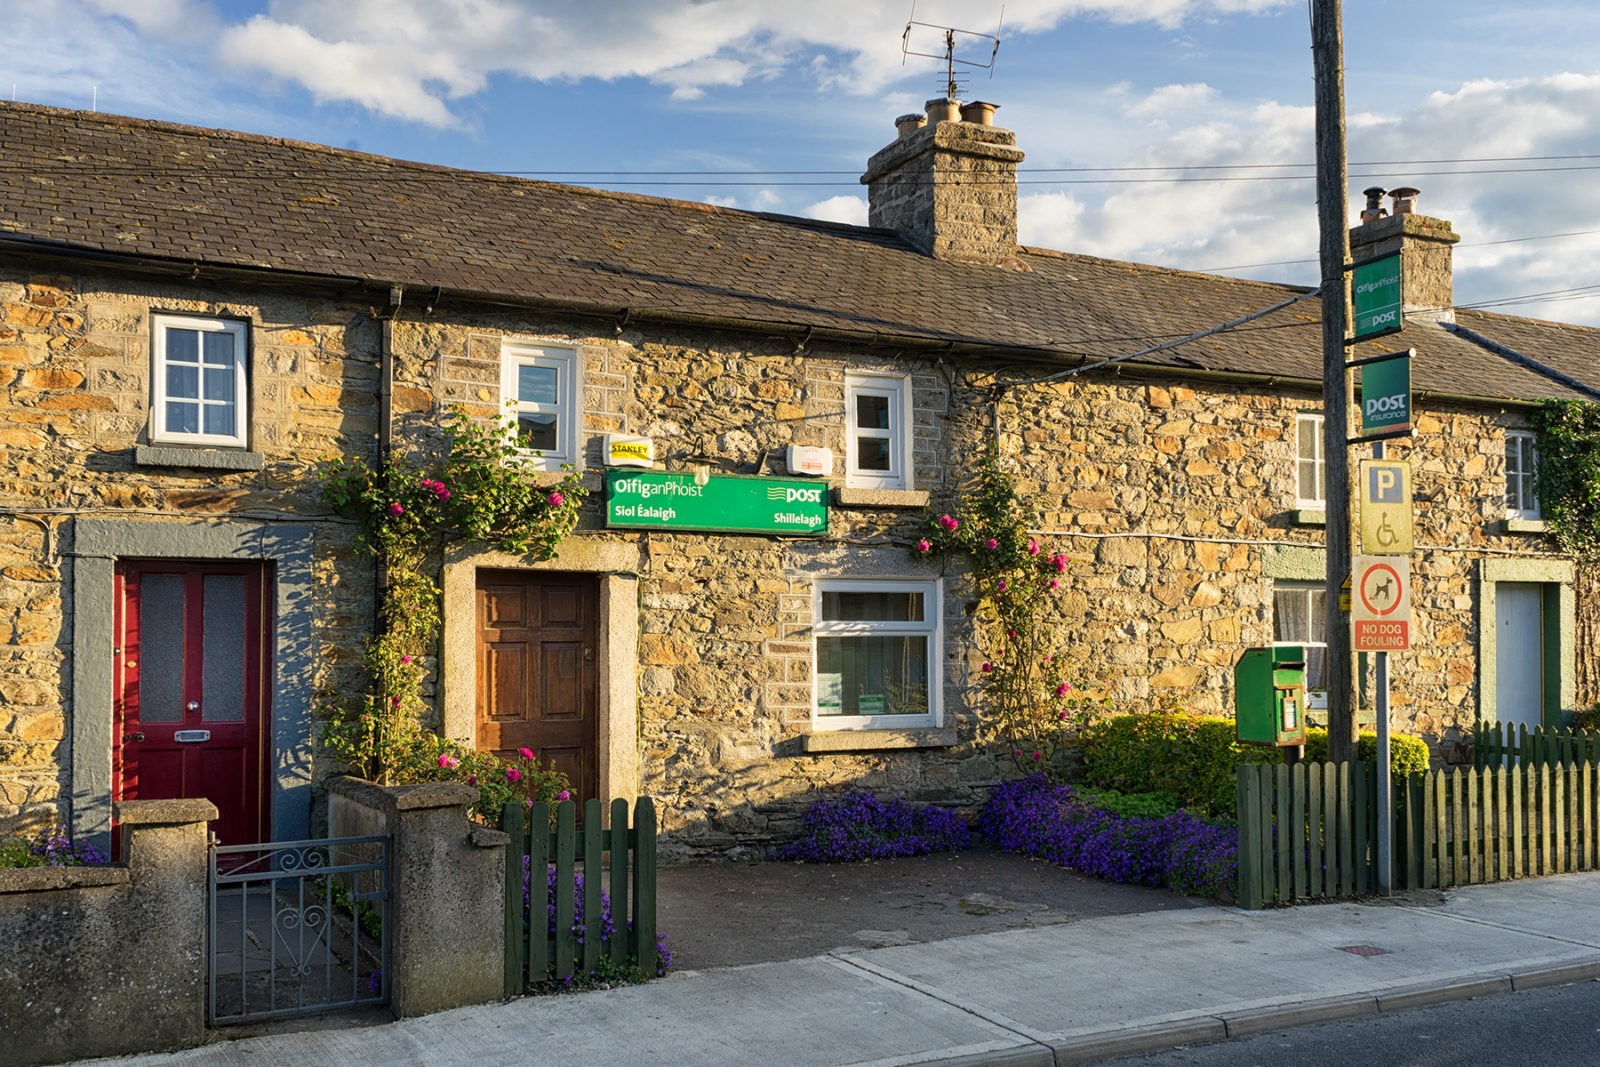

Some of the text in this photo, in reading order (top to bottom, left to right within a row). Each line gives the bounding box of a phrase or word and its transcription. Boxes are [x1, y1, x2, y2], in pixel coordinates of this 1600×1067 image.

[1370, 410, 1406, 421] insurance
[611, 444, 648, 453] STANLEY
[615, 479, 703, 498] OifiganPhoist
[1377, 469, 1395, 500] P
[615, 504, 676, 521] Síol Éalaigh
[774, 512, 822, 527] Shillelagh
[1362, 624, 1402, 634] NO DOG
[1360, 635, 1404, 646] FOULING
